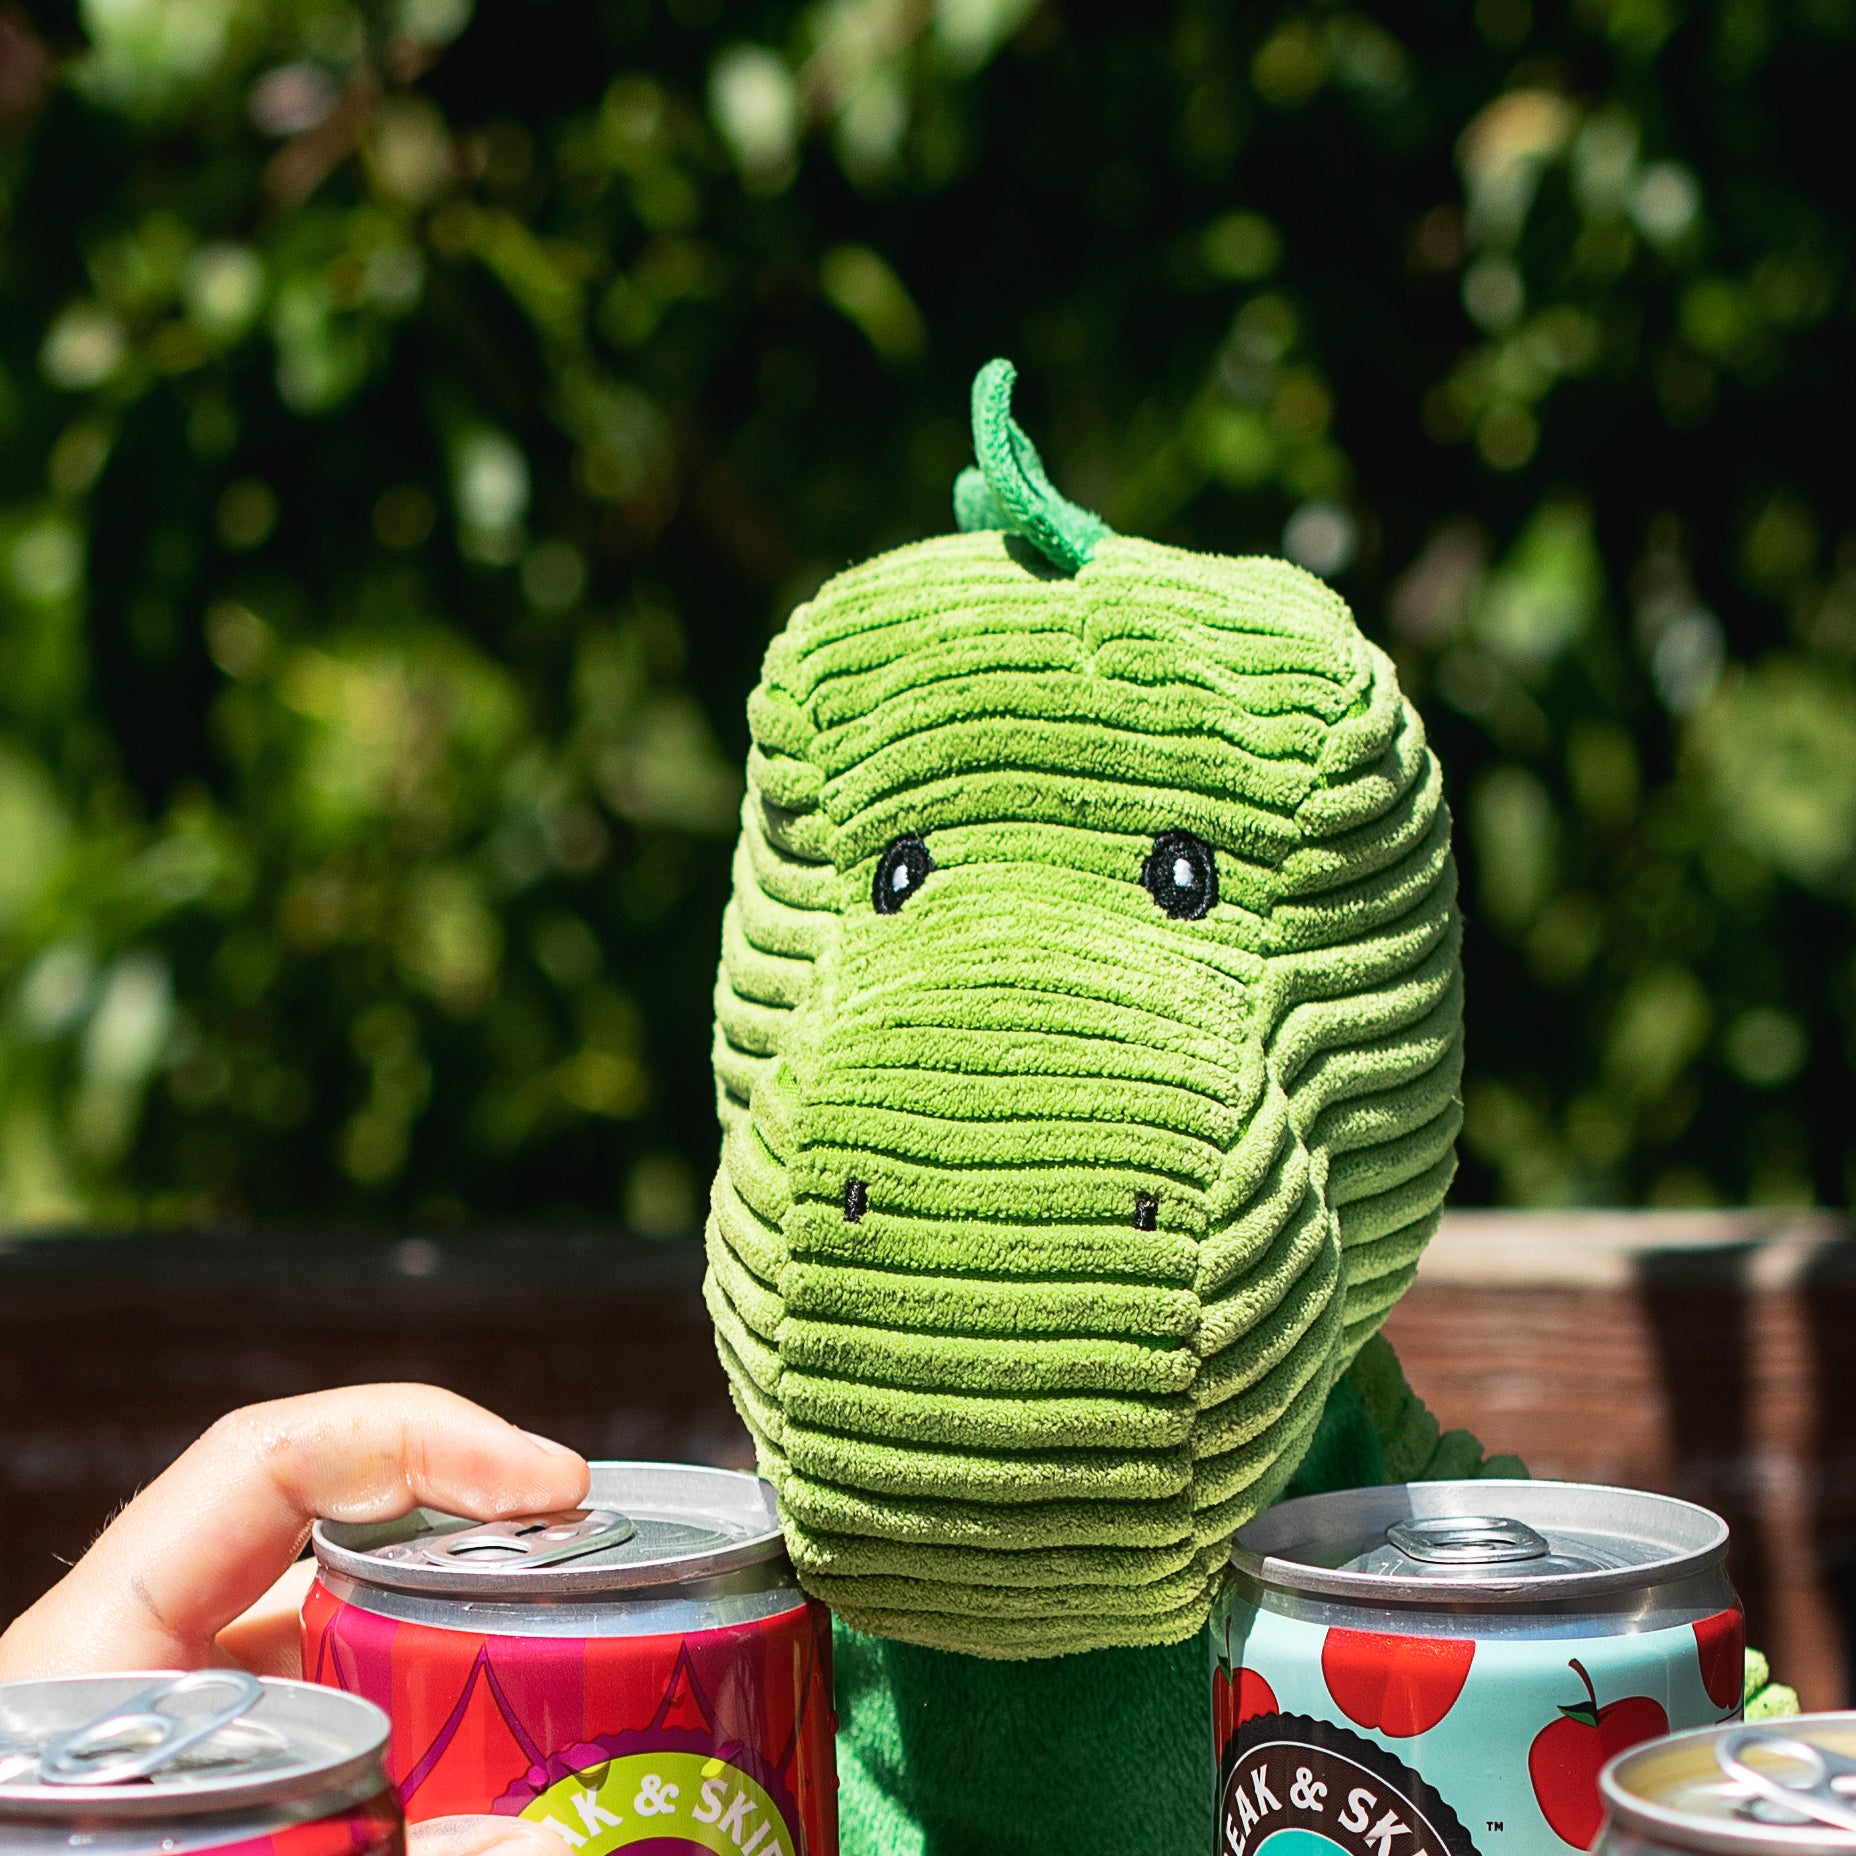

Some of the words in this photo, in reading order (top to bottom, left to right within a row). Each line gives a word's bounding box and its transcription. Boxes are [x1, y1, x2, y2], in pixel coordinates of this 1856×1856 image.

[540, 1784, 624, 1850] AK
[632, 1773, 681, 1817] &
[1289, 1766, 1329, 1814] &
[1486, 1821, 1504, 1832] TM
